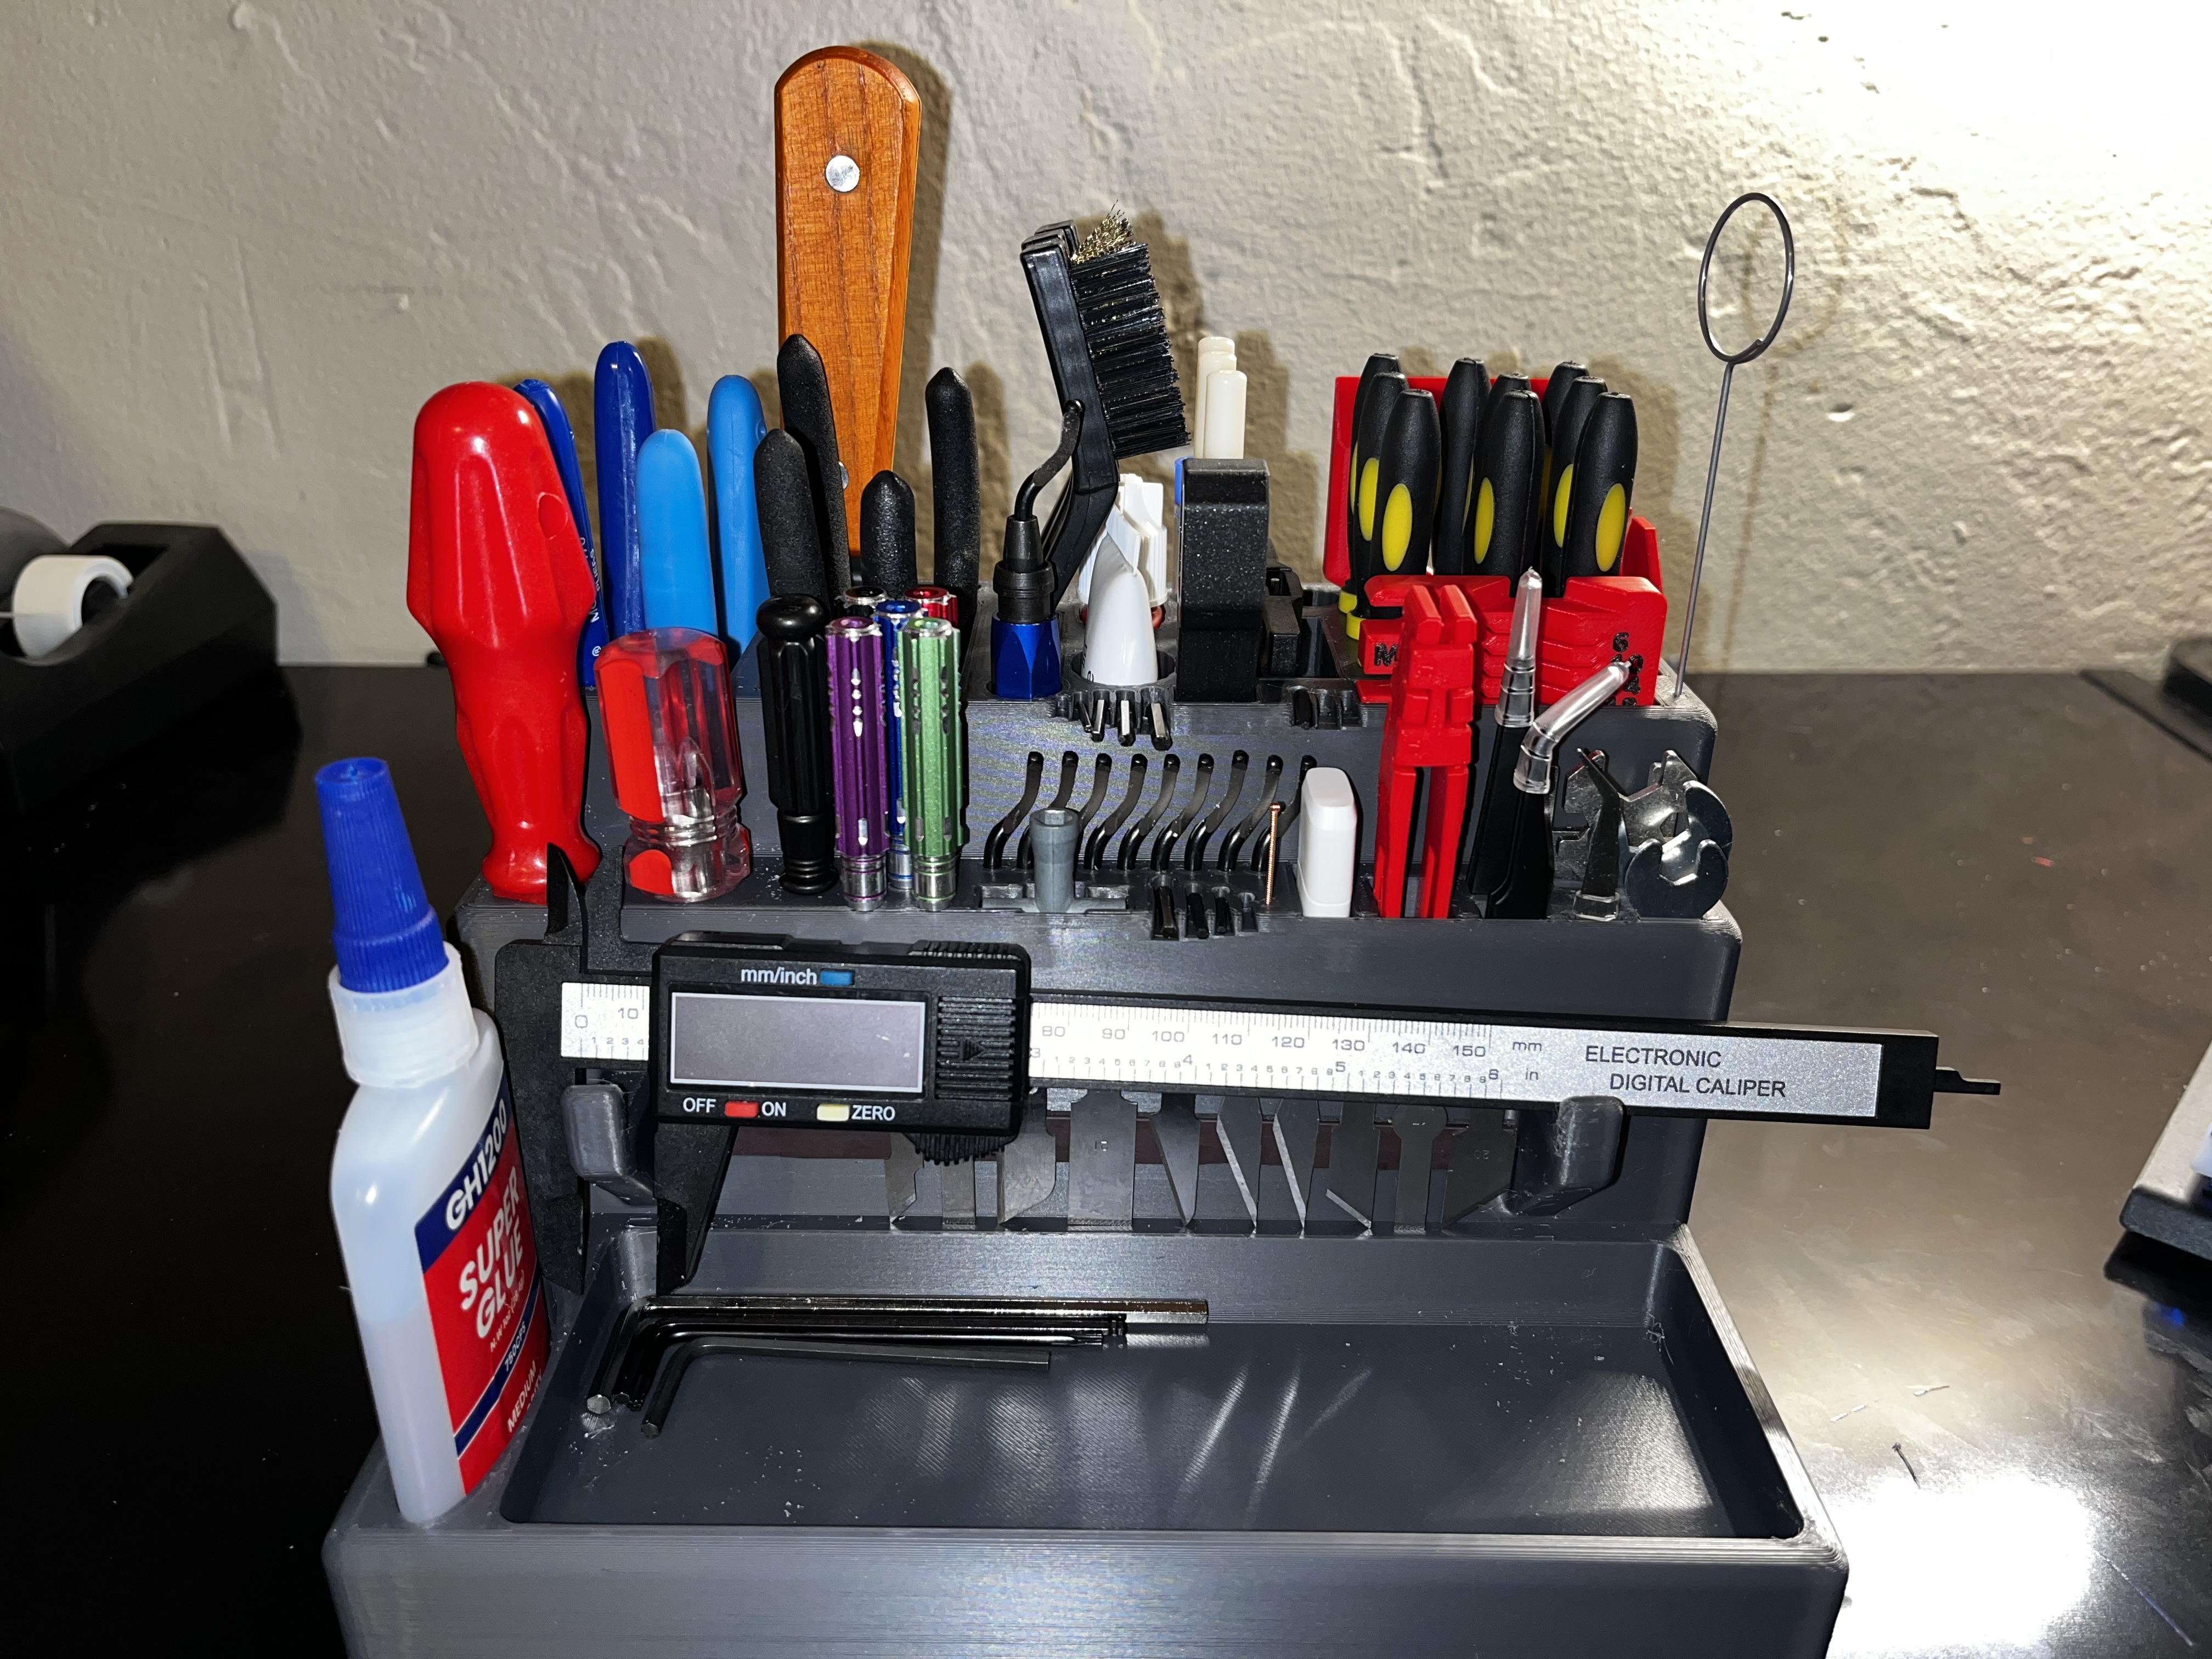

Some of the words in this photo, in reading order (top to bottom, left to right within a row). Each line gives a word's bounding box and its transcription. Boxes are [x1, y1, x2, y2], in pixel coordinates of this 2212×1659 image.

[741, 966, 817, 985] mm/inch
[575, 1014, 588, 1028] 0
[618, 1007, 639, 1019] 10
[1042, 1025, 1065, 1037] 80
[1102, 1028, 1125, 1040] 90
[1152, 1031, 1184, 1042] 100
[1212, 1034, 1242, 1045] 110
[1272, 1036, 1305, 1048] 120
[1332, 1039, 1365, 1051] 130
[1392, 1042, 1425, 1054] 140
[1453, 1045, 1486, 1057] 150
[1513, 1041, 1542, 1052] mm
[1183, 1054, 1193, 1065] 4
[1335, 1061, 1346, 1072] 5
[1388, 1071, 1395, 1079] 3
[1525, 1068, 1538, 1080] in
[1585, 1045, 1722, 1068] ELECTRONIC
[1610, 1073, 1690, 1093] DIGITAL
[1696, 1077, 1786, 1097] CALIPER
[682, 1097, 716, 1114] OFF
[761, 1101, 787, 1116] ON
[851, 1104, 895, 1121] ZERO
[446, 1098, 506, 1230] GH1200
[460, 1166, 520, 1311] SUPER
[476, 1215, 523, 1339] GLUE
[504, 1321, 526, 1372] 750CPS
[507, 1359, 536, 1433] MEDIUM
